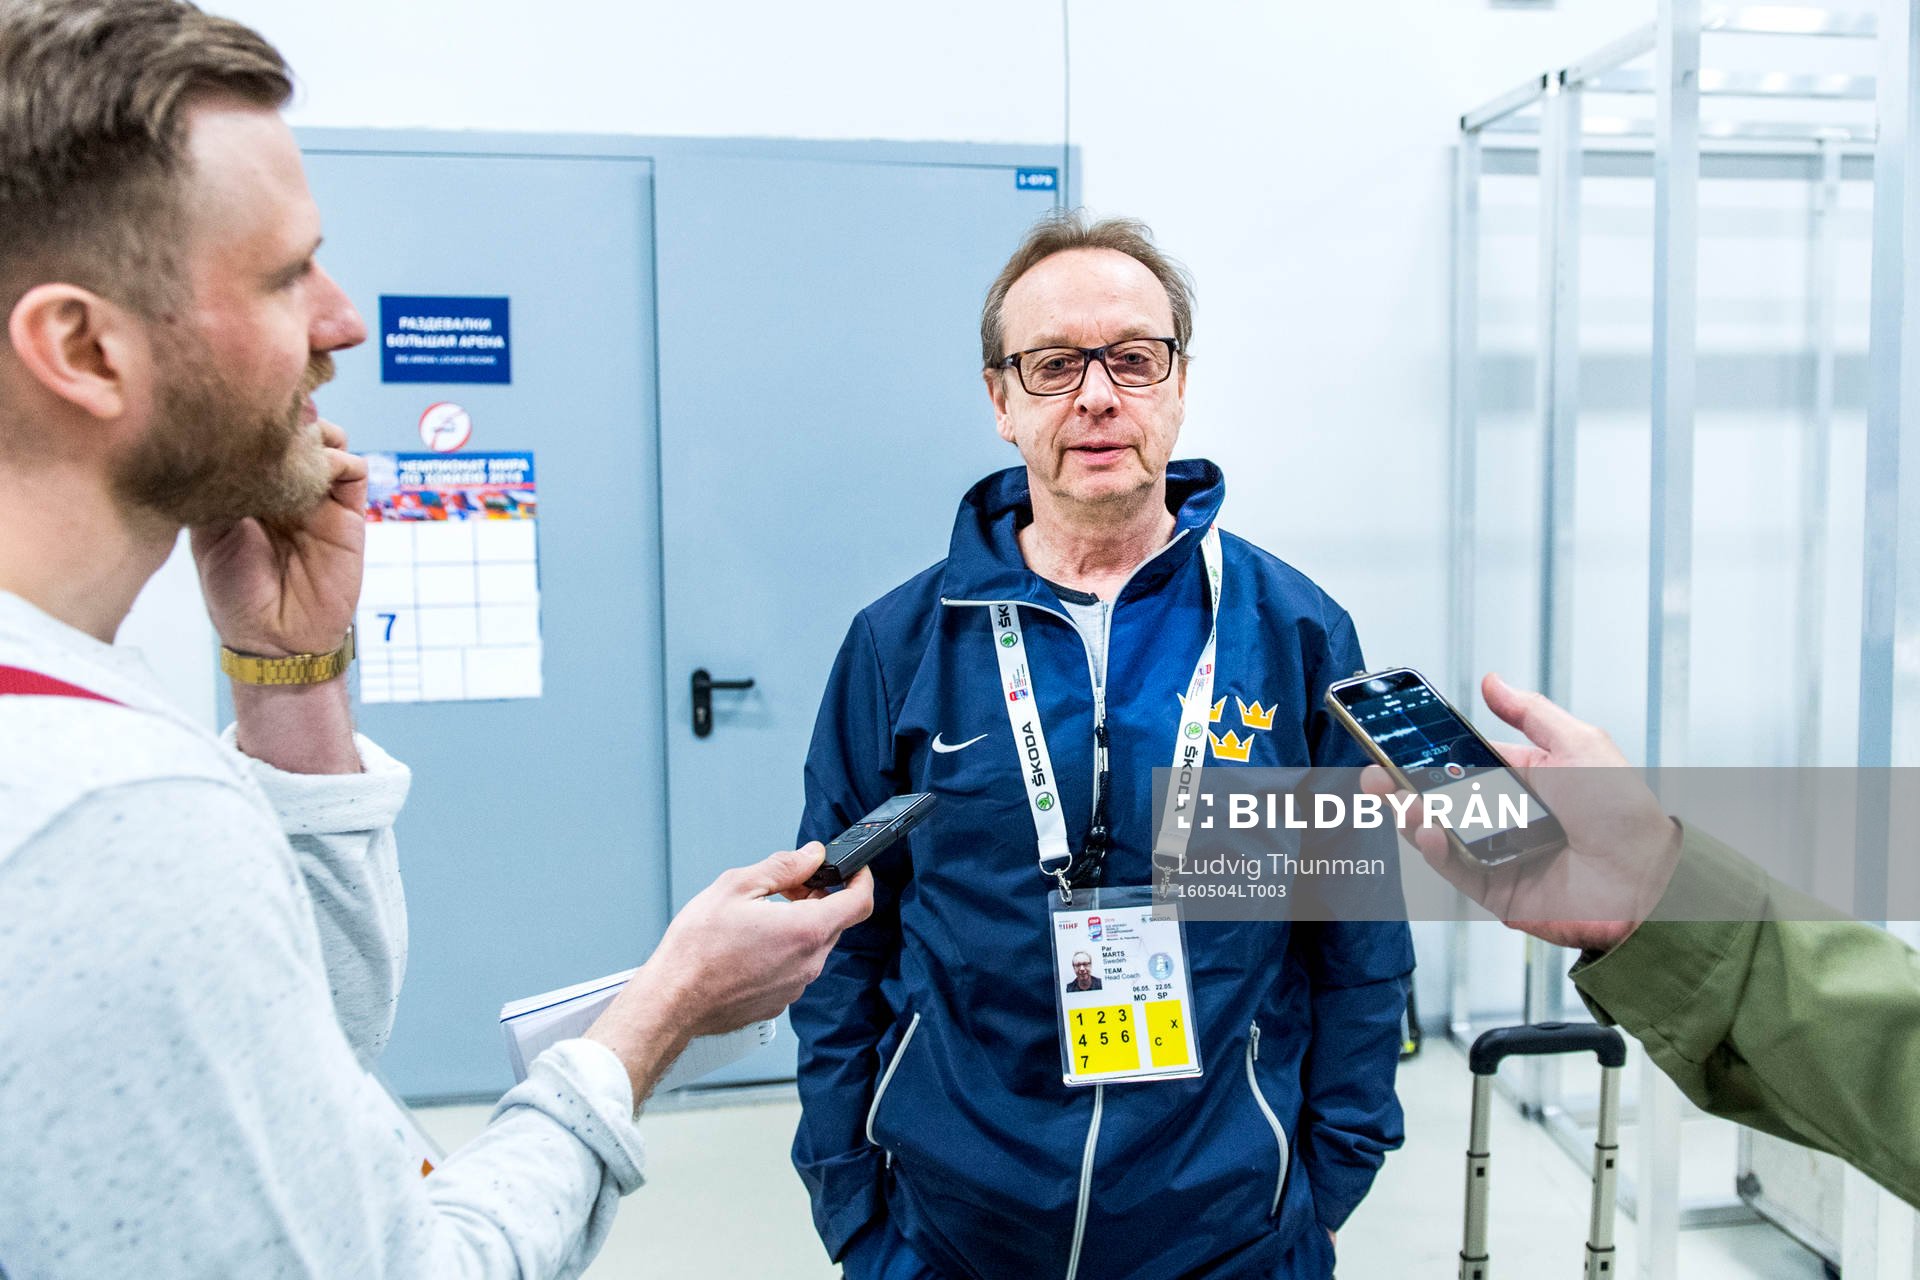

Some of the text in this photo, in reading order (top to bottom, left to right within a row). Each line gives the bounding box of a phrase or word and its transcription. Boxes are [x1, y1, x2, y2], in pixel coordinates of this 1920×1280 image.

[398, 316, 492, 331] РАЗДЕВАЛКИ
[386, 333, 505, 349] БОЛЬШАЯ АРЕНА
[377, 613, 397, 641] 7
[1022, 721, 1046, 787] ŠKODA
[1103, 957, 1127, 965] Sweden
[1121, 972, 1141, 980] Coach
[1076, 1009, 1127, 1026] 1 2 3
[1171, 1019, 1178, 1029] X
[1078, 1030, 1130, 1047] 4 5 6
[1155, 1037, 1163, 1046] C
[1081, 1055, 1089, 1068] 7
